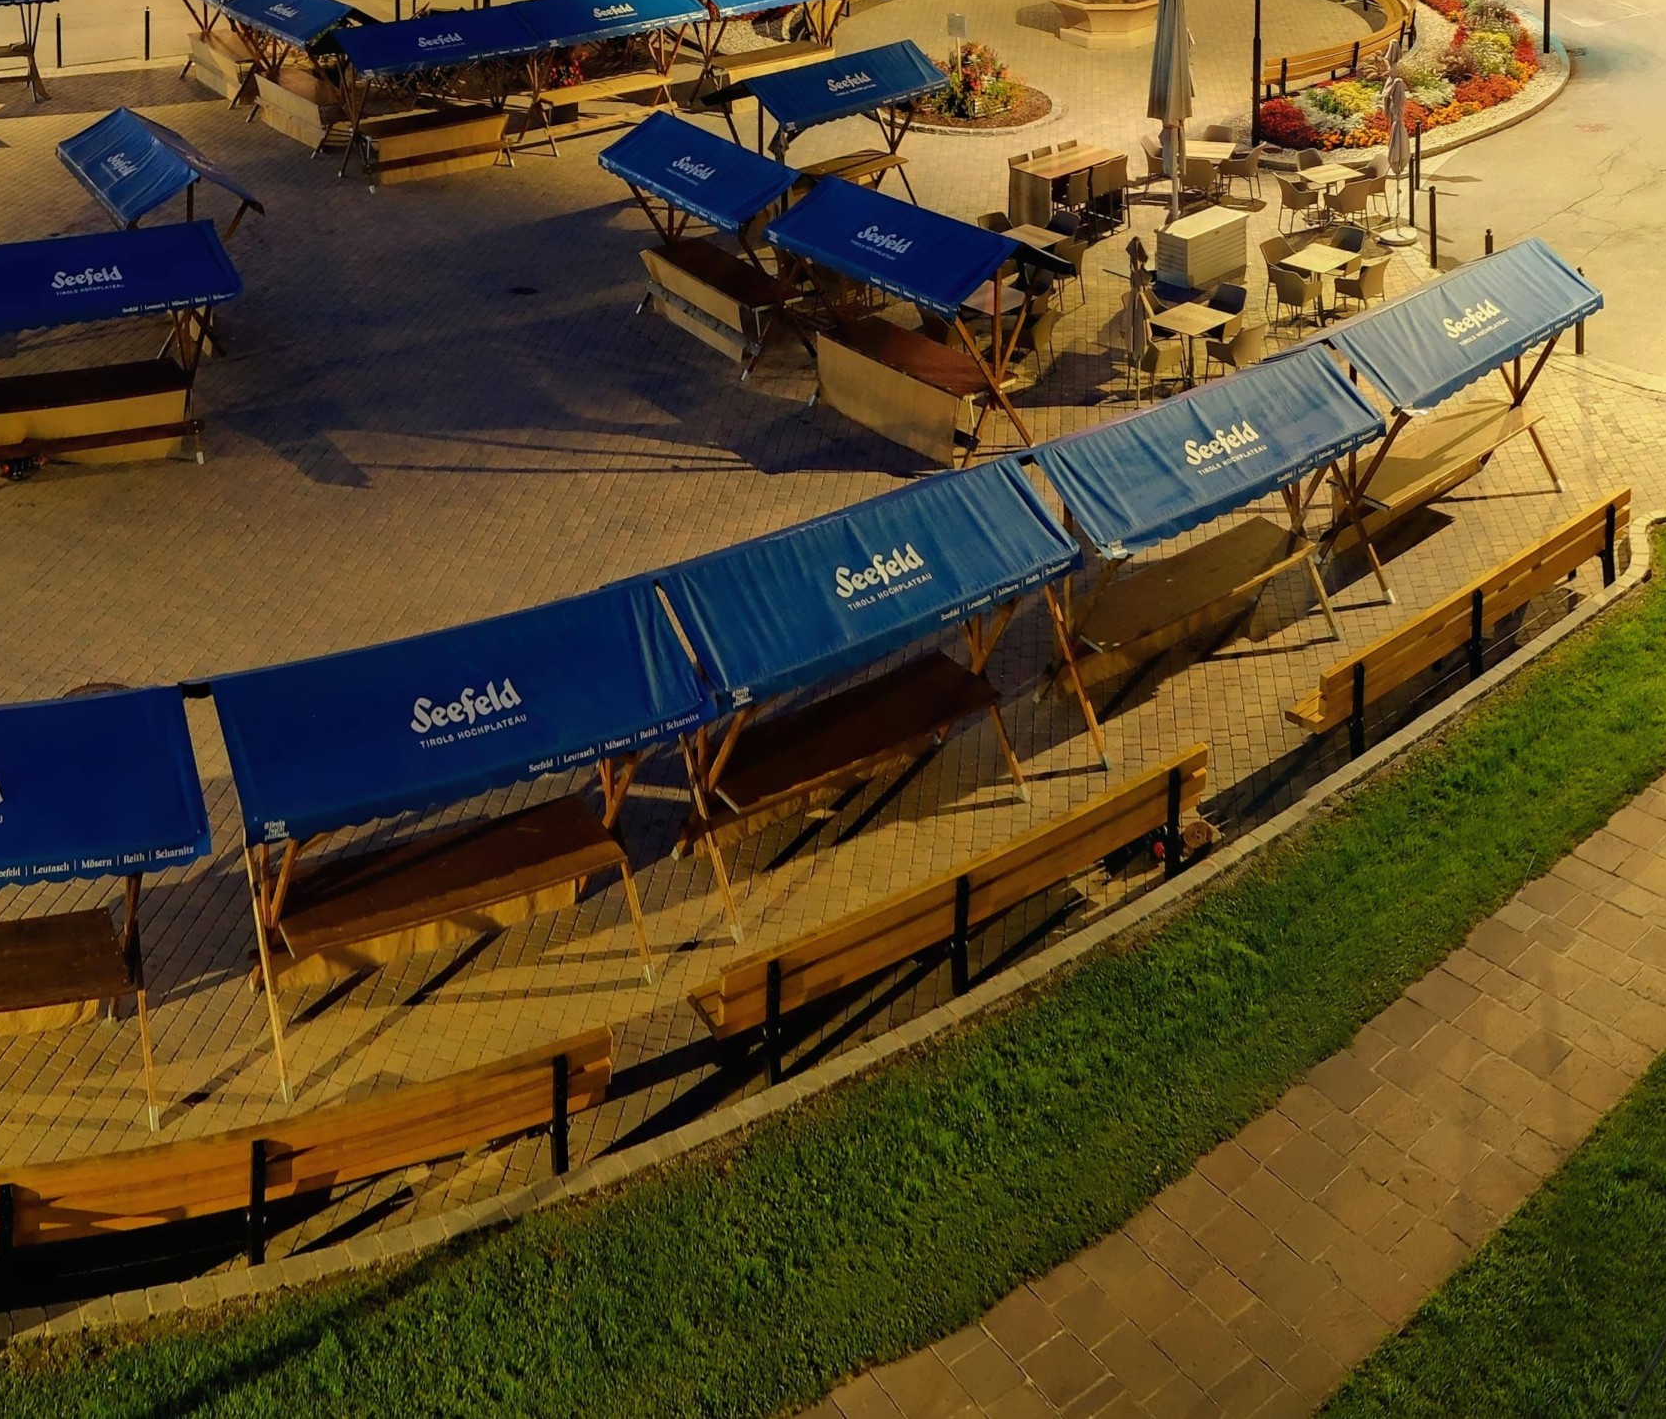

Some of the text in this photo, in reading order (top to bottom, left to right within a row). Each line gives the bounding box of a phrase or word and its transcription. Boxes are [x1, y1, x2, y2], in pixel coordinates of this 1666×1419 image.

[593, 3, 635, 18] Seefeld
[418, 32, 463, 48] Seefeld
[827, 71, 872, 92] Seefeld
[672, 156, 716, 181] Seefeld
[857, 225, 914, 254] Seefeld
[51, 265, 123, 289] Seefeld
[1443, 298, 1501, 339] Seefeld
[1185, 420, 1260, 466] Seefeld
[835, 543, 924, 598] Seefeld
[847, 572, 933, 612] TIROLS HOCHPLATEAU
[410, 678, 522, 734] Seefeld
[419, 713, 527, 749] TIROLS HOCHPLATEAU
[528, 713, 700, 773] Seefeld Leutasch Mösern Reith Scharnitz
[33, 860, 69, 876] Leutasch
[80, 856, 112, 870] Mösern
[122, 852, 146, 865] Reith
[154, 845, 194, 859] Scharnitz
